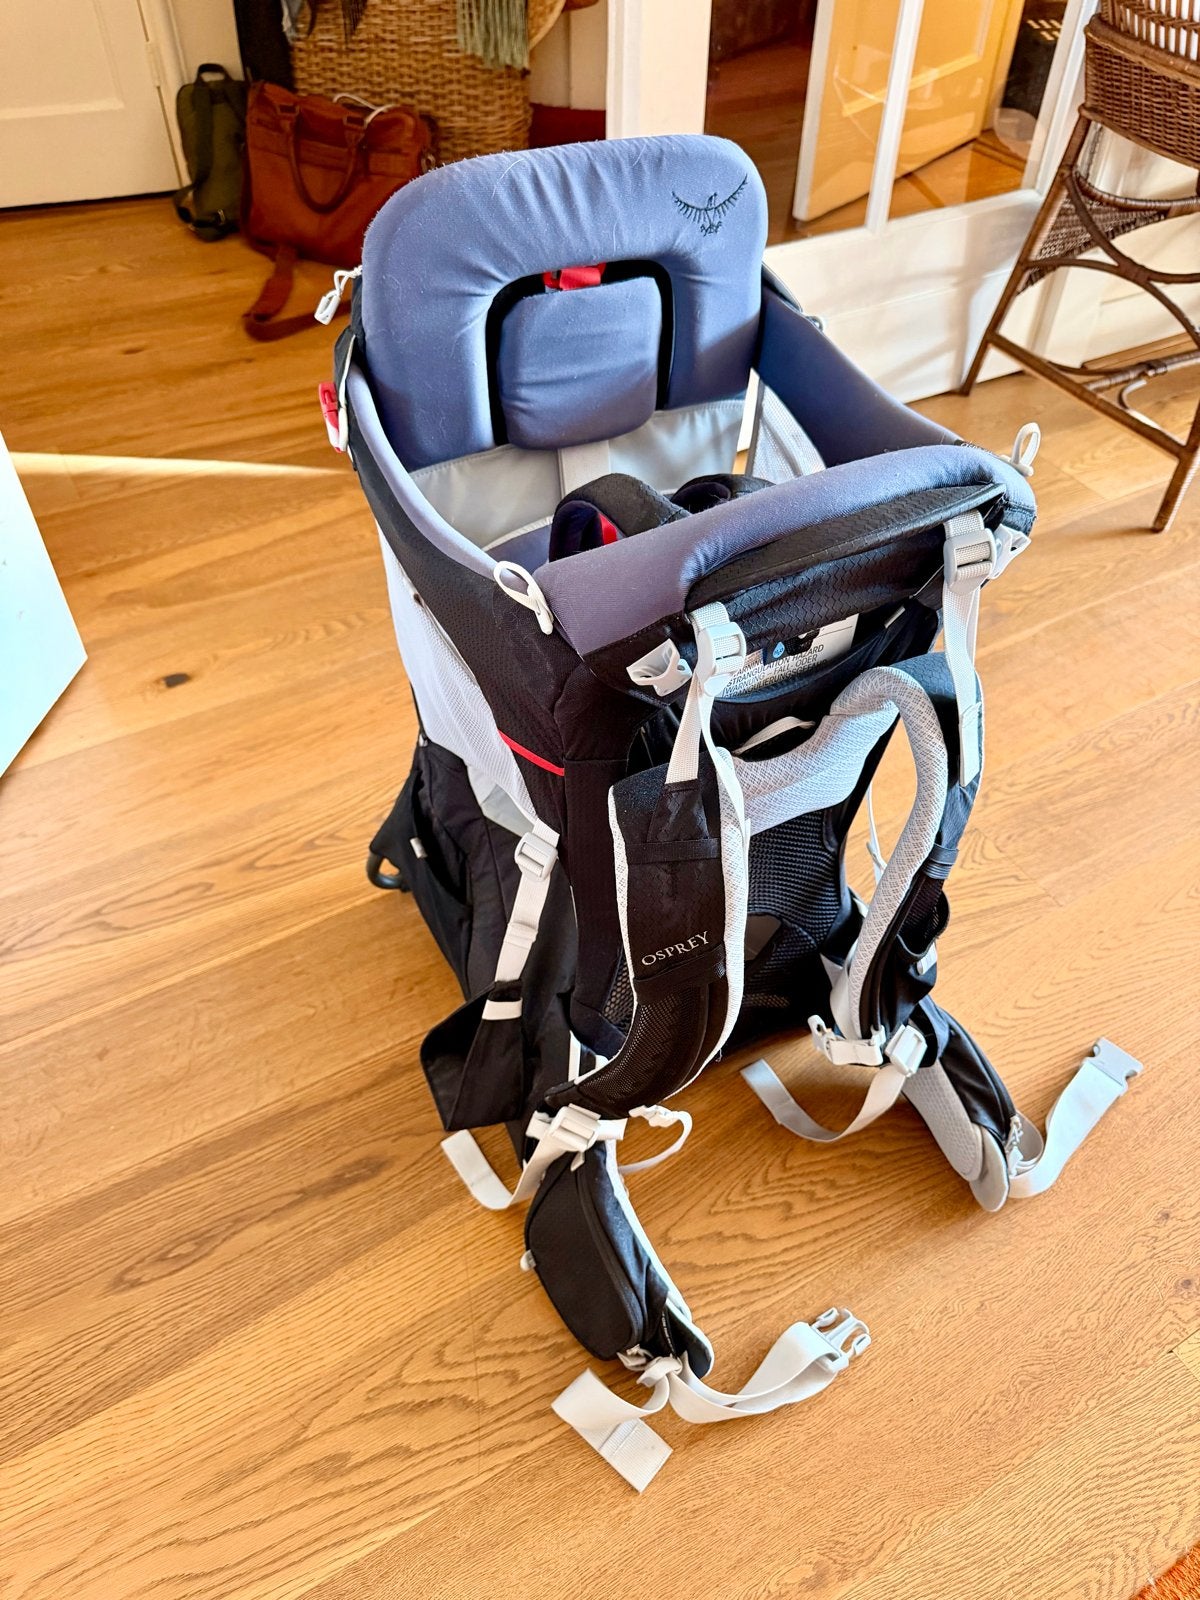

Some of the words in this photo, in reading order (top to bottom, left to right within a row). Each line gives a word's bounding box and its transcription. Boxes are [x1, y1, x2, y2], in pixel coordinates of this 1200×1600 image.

[734, 658, 763, 676] ARNING
[796, 654, 818, 667] ODER
[641, 930, 709, 966] OSPREY
